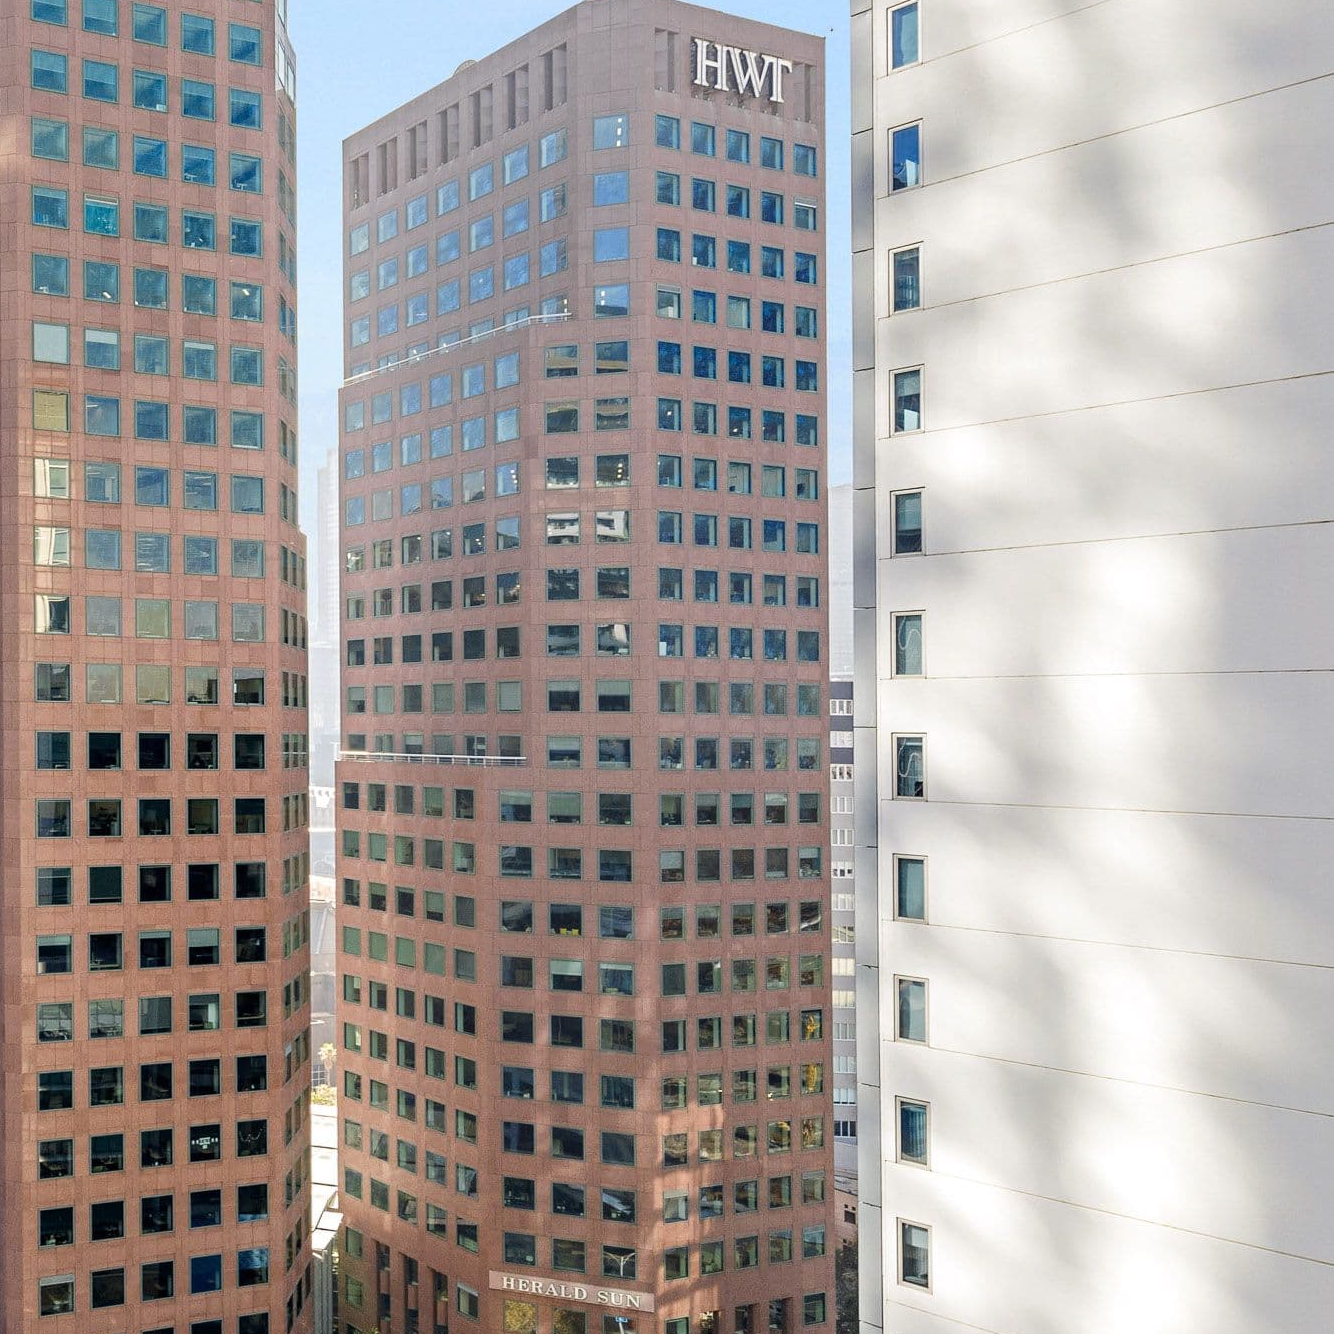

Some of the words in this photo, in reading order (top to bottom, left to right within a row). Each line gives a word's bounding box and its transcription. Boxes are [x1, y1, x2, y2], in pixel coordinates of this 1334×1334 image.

[693, 38, 793, 104] HWT
[501, 1276, 588, 1300] HERALD
[597, 1290, 641, 1308] SUN
